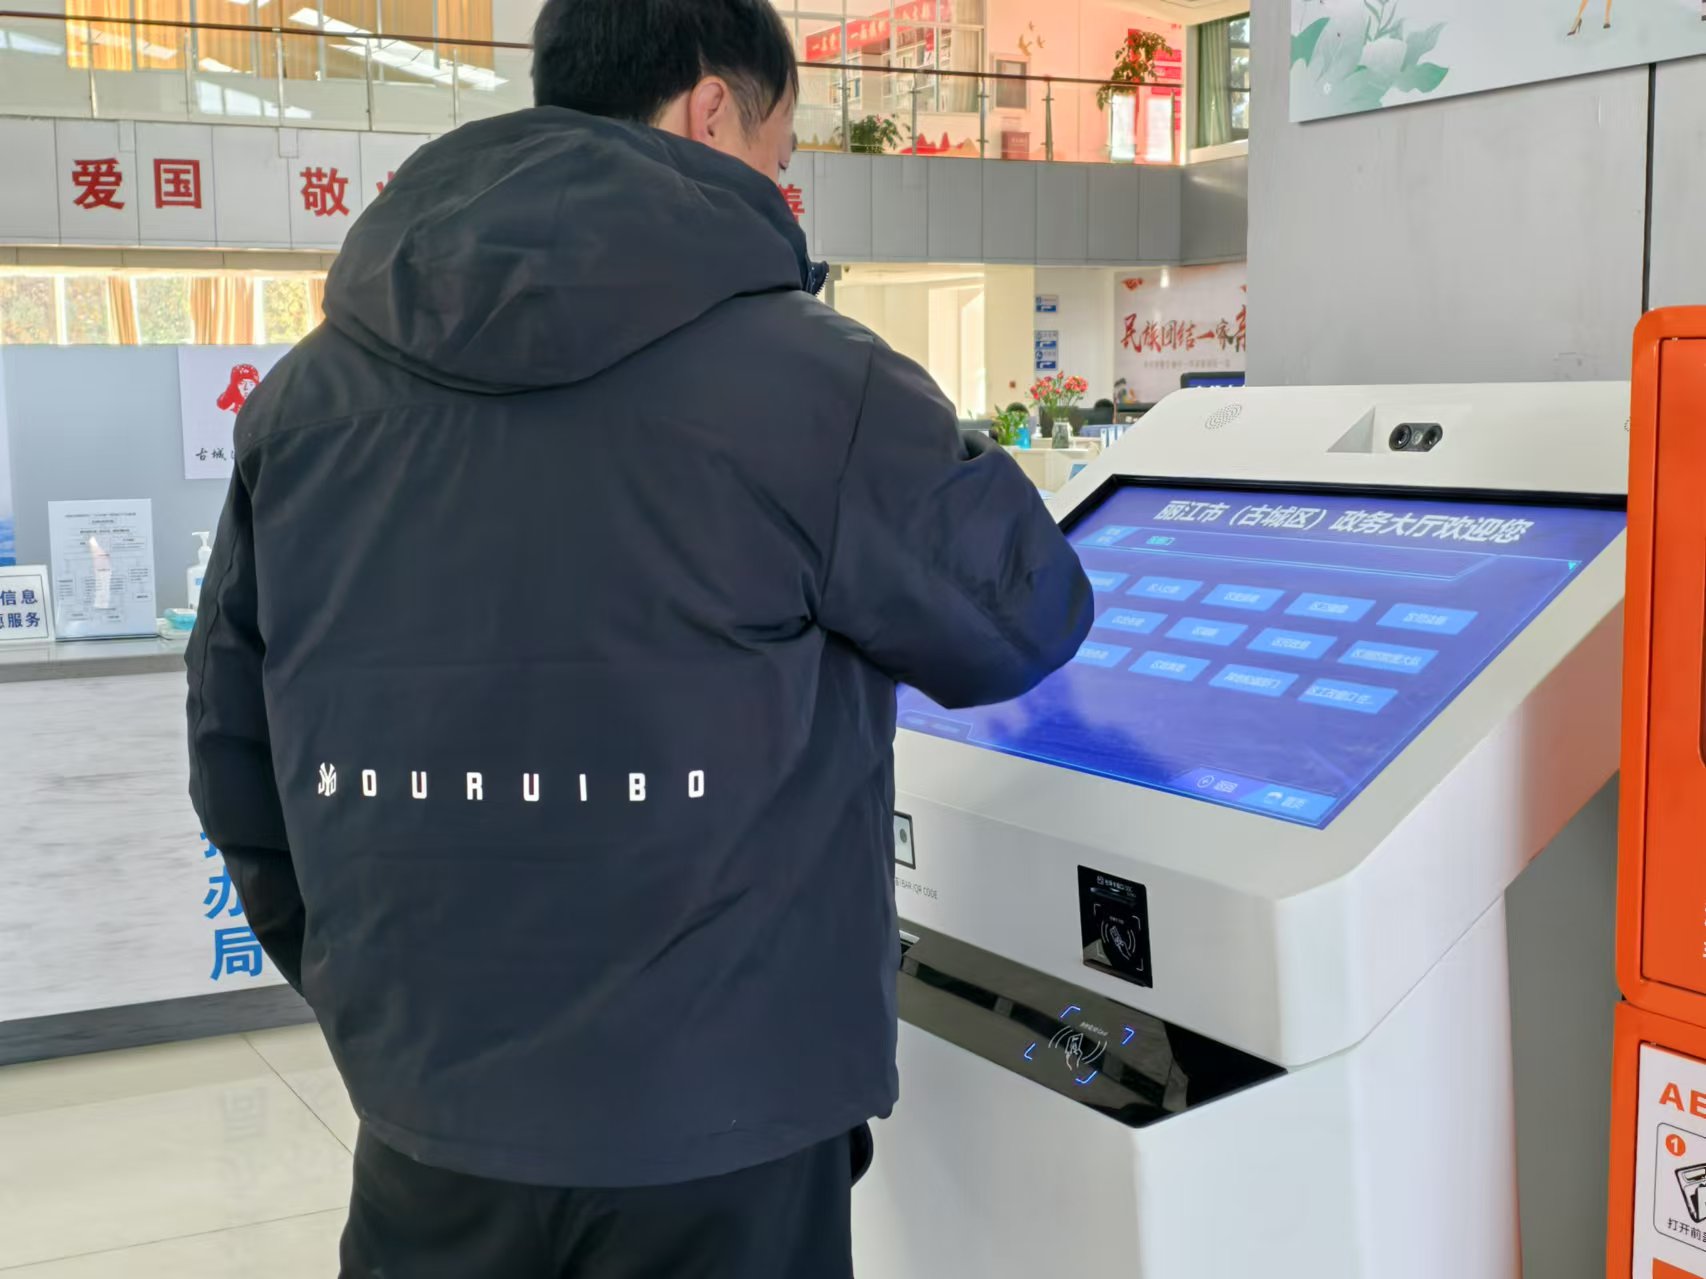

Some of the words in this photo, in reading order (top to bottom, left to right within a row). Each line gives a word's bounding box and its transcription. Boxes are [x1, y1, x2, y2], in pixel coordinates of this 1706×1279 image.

[71, 157, 202, 210] 爱国
[195, 447, 235, 461] 古城
[0, 589, 38, 606] 信息
